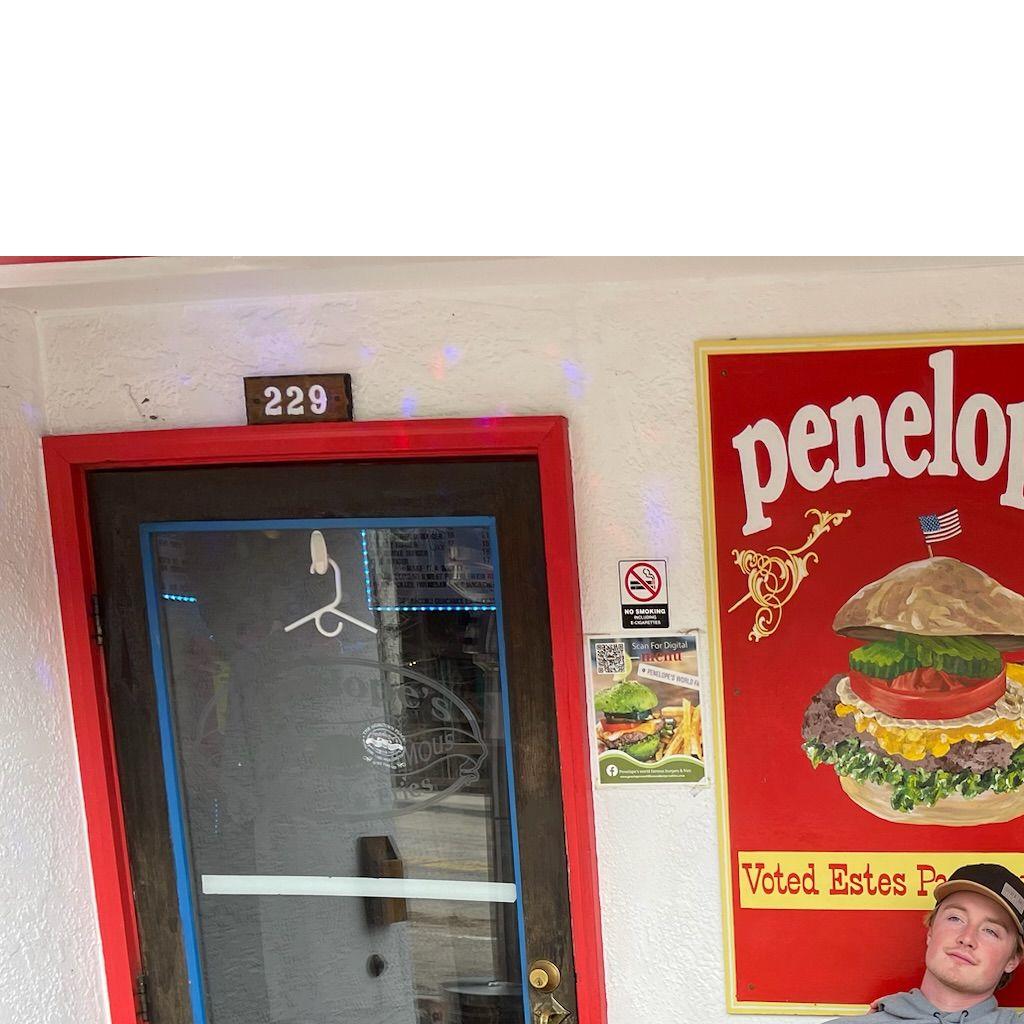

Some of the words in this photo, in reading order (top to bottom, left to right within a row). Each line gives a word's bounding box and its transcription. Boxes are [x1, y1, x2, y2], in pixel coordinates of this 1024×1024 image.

[264, 384, 328, 416] 229
[632, 642, 649, 650] Scan
[651, 642, 663, 650] For
[664, 641, 688, 650] Digital
[641, 652, 682, 662] menu
[741, 863, 820, 897] Voted
[828, 863, 907, 897] Estes
